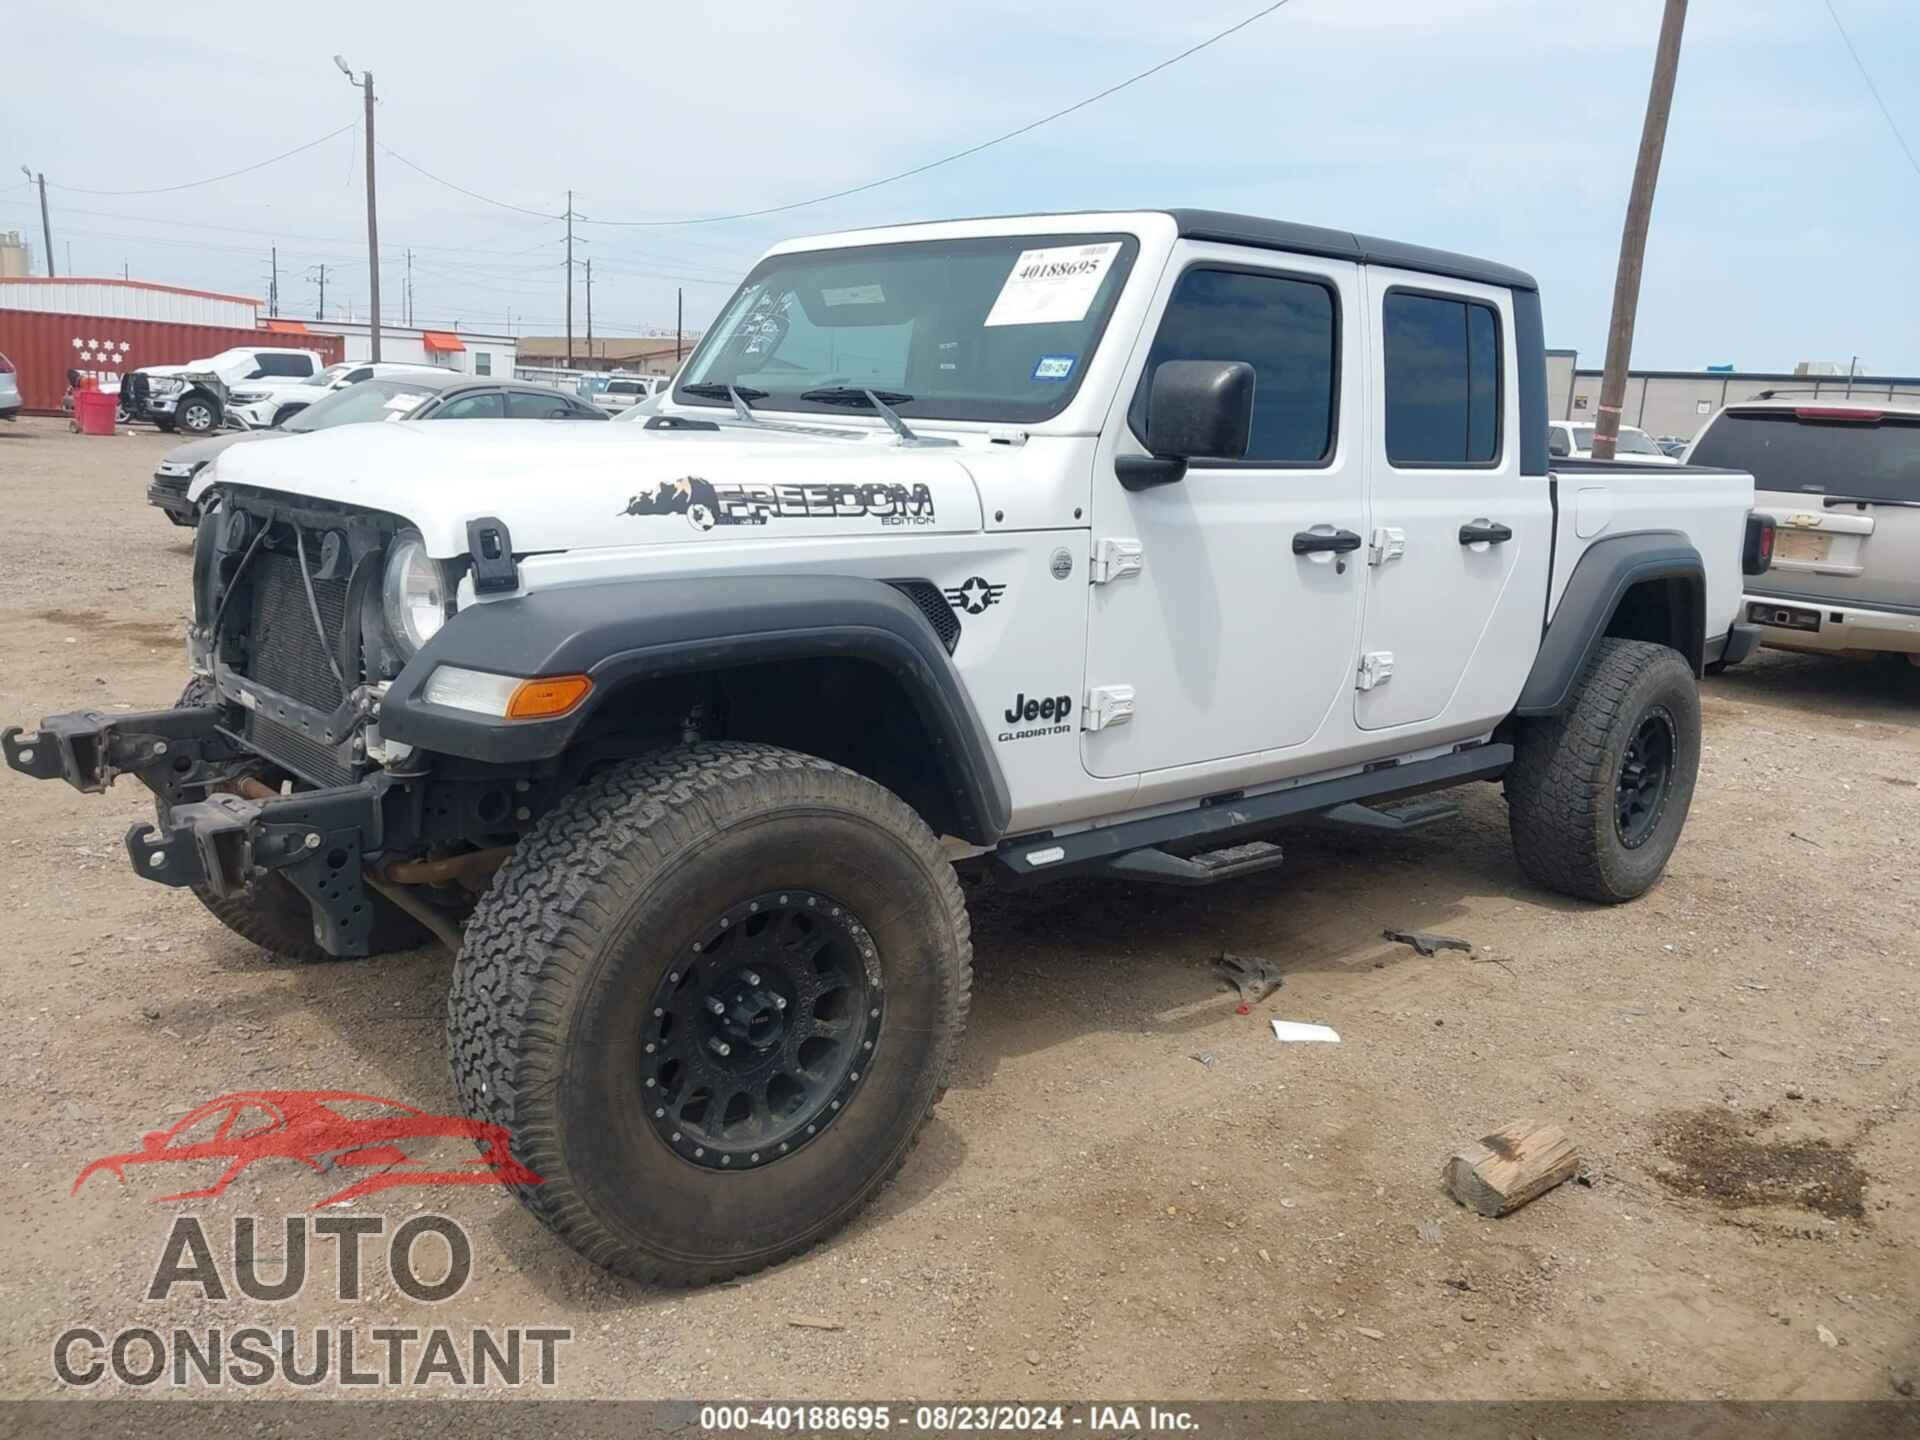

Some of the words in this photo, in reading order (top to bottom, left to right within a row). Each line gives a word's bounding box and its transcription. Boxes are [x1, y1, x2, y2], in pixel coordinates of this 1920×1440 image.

[1019, 258, 1100, 280] 40188695
[711, 483, 935, 518] FREEDOM
[881, 516, 936, 527] EDITION
[1004, 693, 1072, 724] Jeep
[998, 725, 1071, 742] GLADIATOR
